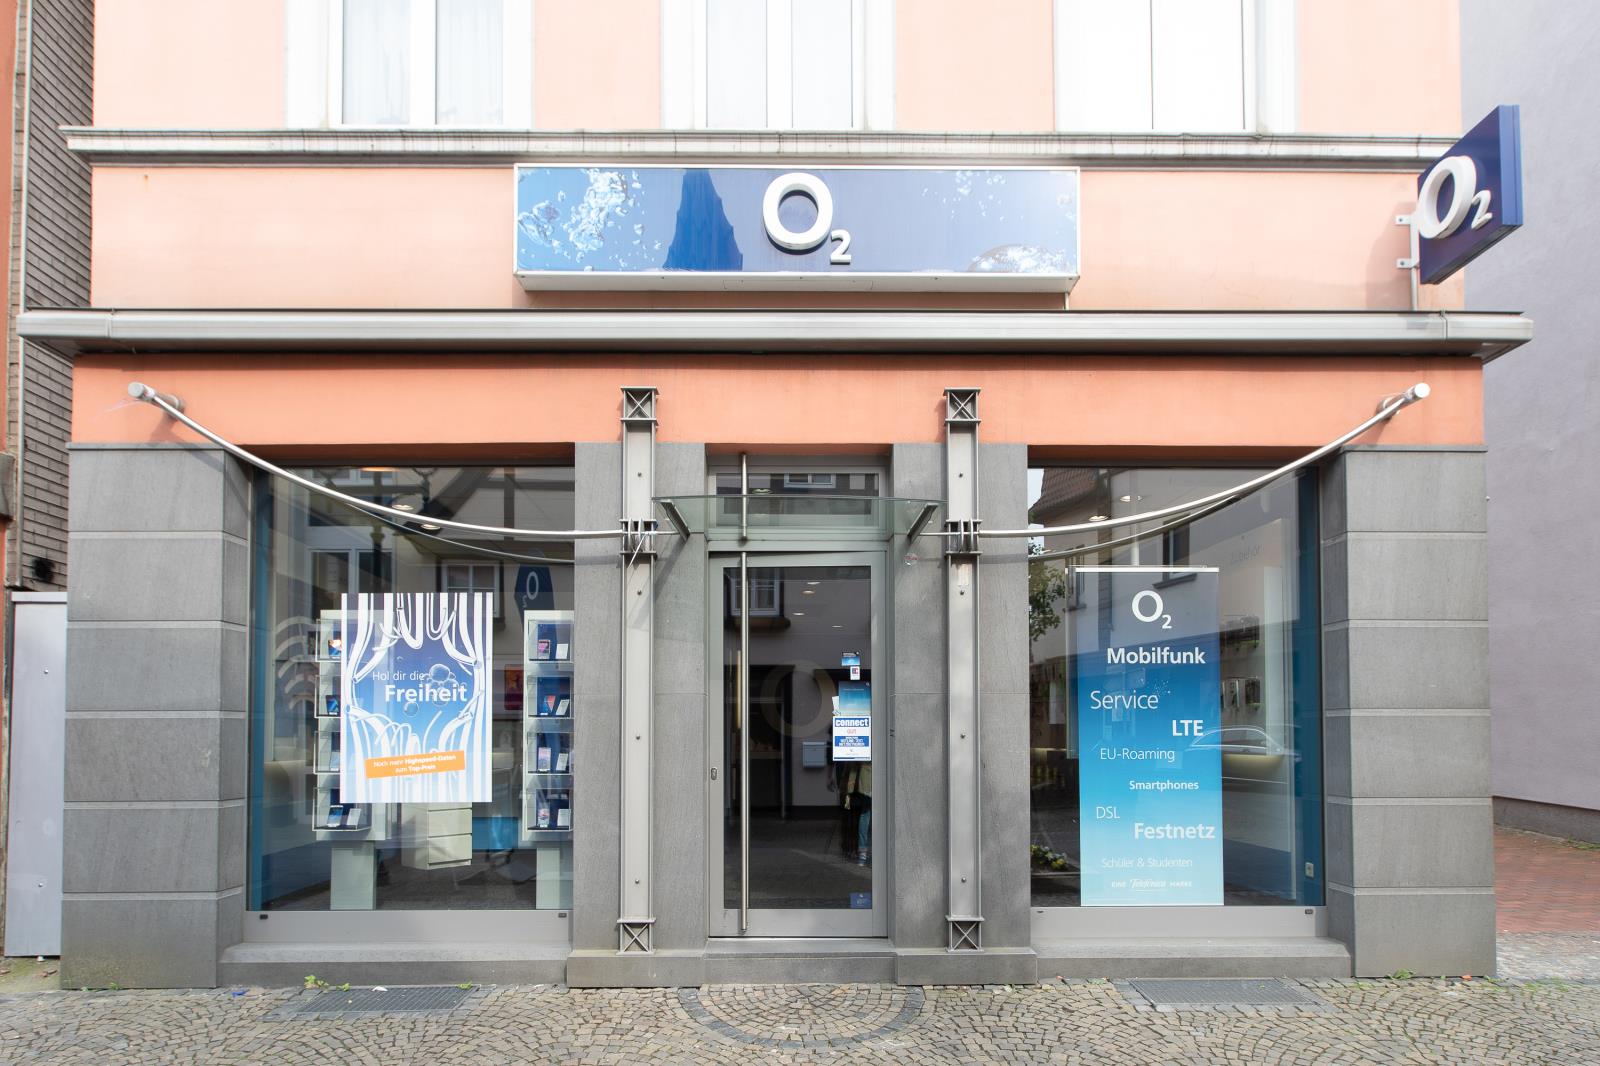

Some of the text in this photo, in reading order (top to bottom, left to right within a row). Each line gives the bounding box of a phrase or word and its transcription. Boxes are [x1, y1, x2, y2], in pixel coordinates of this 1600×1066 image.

[1107, 647, 1206, 664] Mobilfunk
[372, 670, 425, 681] Hol dir die
[386, 683, 467, 701] Freiheit
[1090, 690, 1159, 709] Service
[1172, 719, 1204, 737] LTE
[1100, 747, 1176, 762] EU-Roaming
[1129, 780, 1200, 792] Smartphones
[1096, 806, 1120, 819] DSL
[1134, 822, 1216, 839] Festnetz
[1136, 857, 1145, 868] &
[1147, 857, 1193, 868] Studenten
